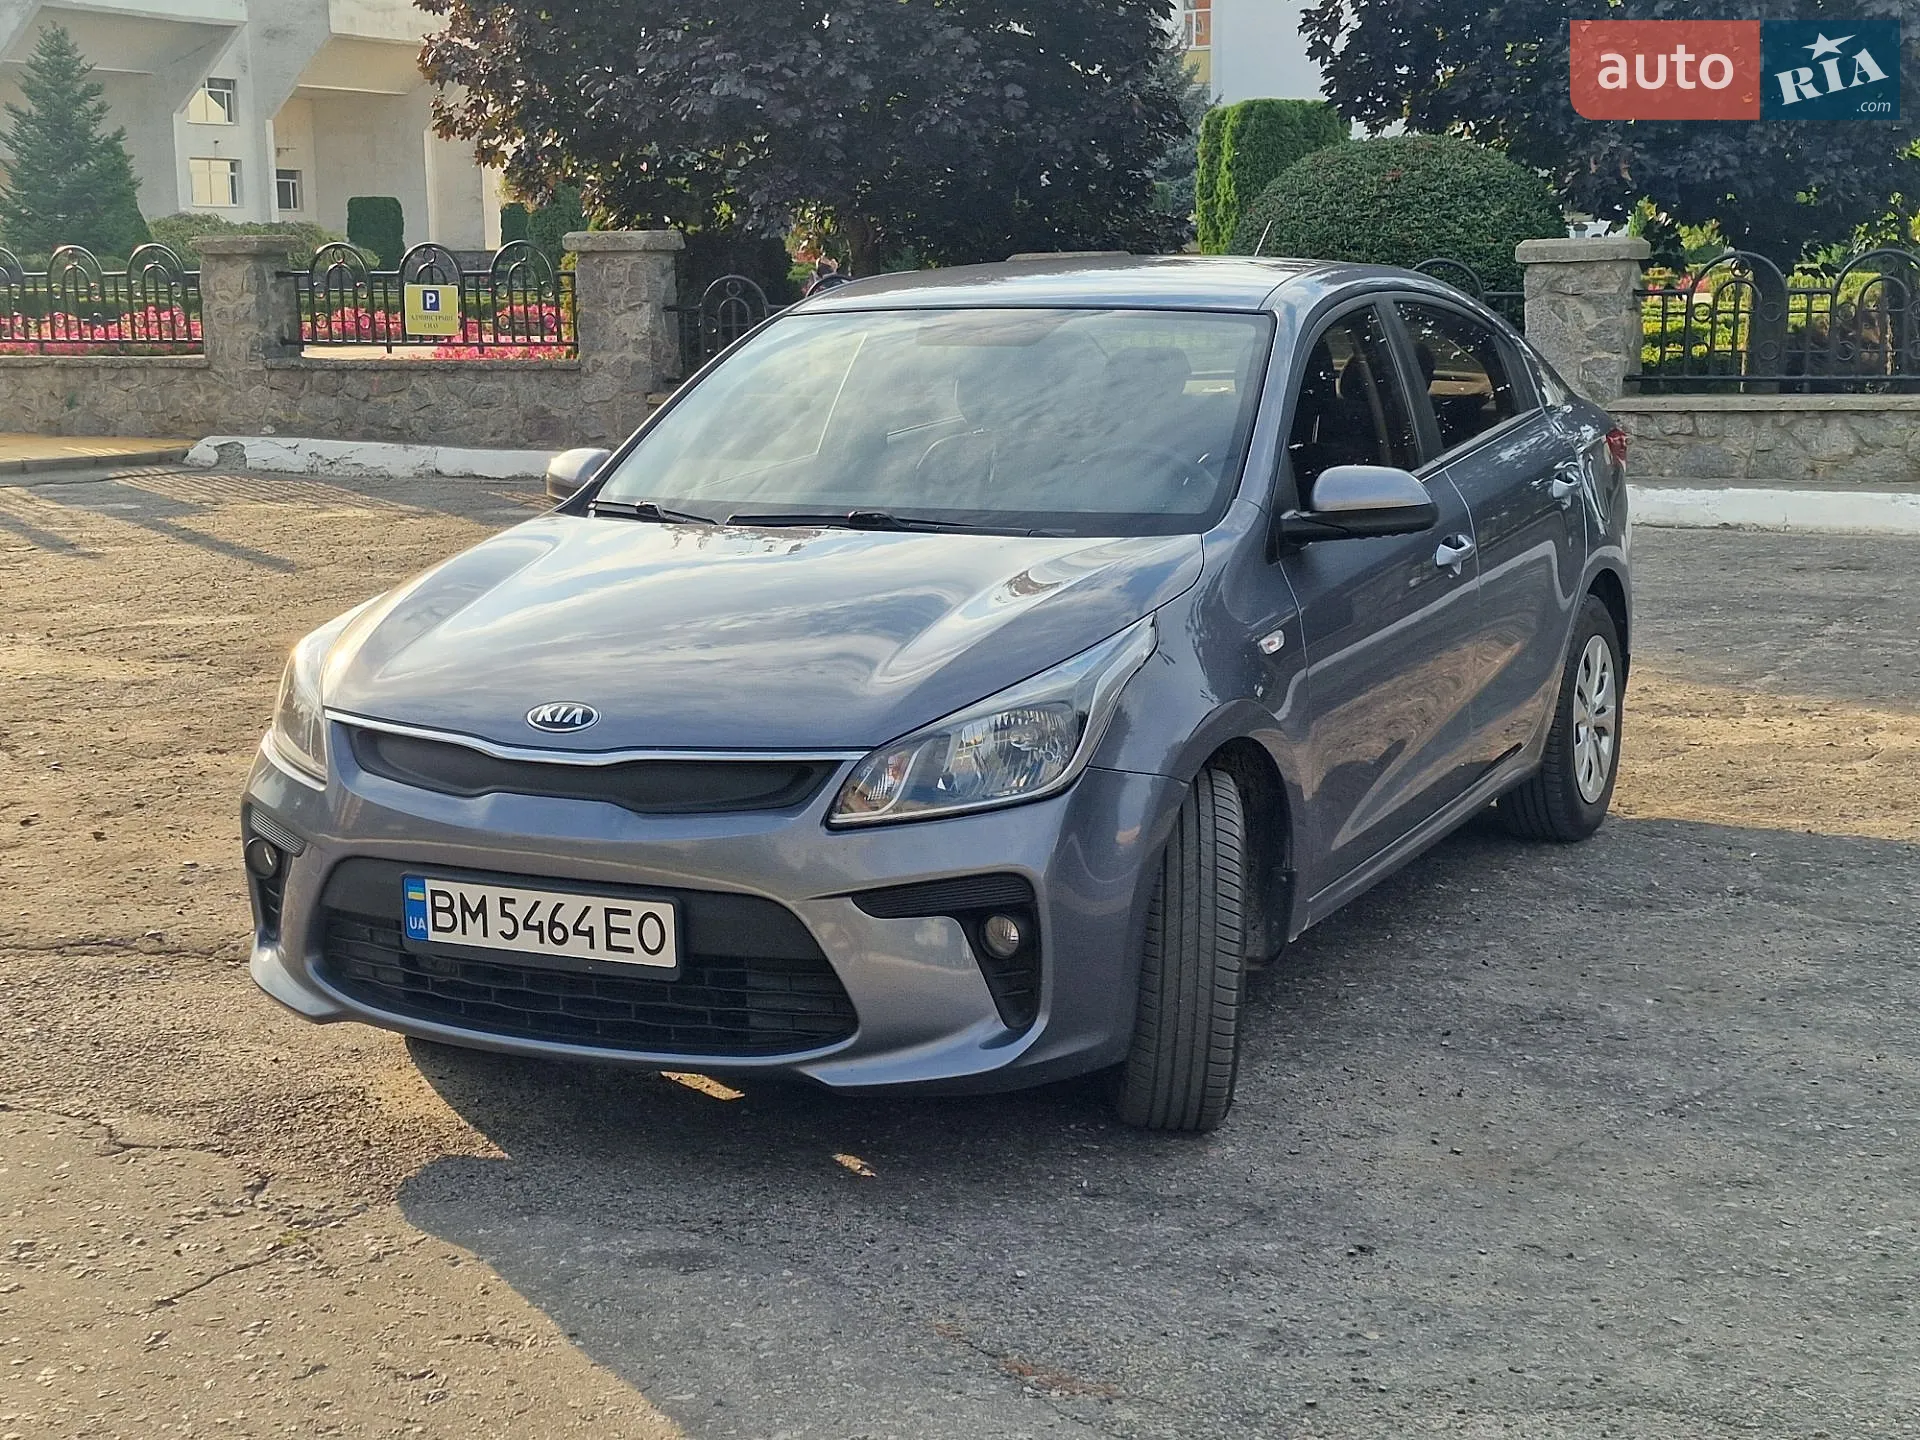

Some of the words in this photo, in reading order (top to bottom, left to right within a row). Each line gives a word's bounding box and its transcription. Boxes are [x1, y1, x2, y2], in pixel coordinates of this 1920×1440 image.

[426, 292, 436, 310] P
[536, 706, 584, 725] KIA
[409, 916, 426, 931] UA
[430, 889, 488, 938] BM
[499, 897, 595, 950] 5464
